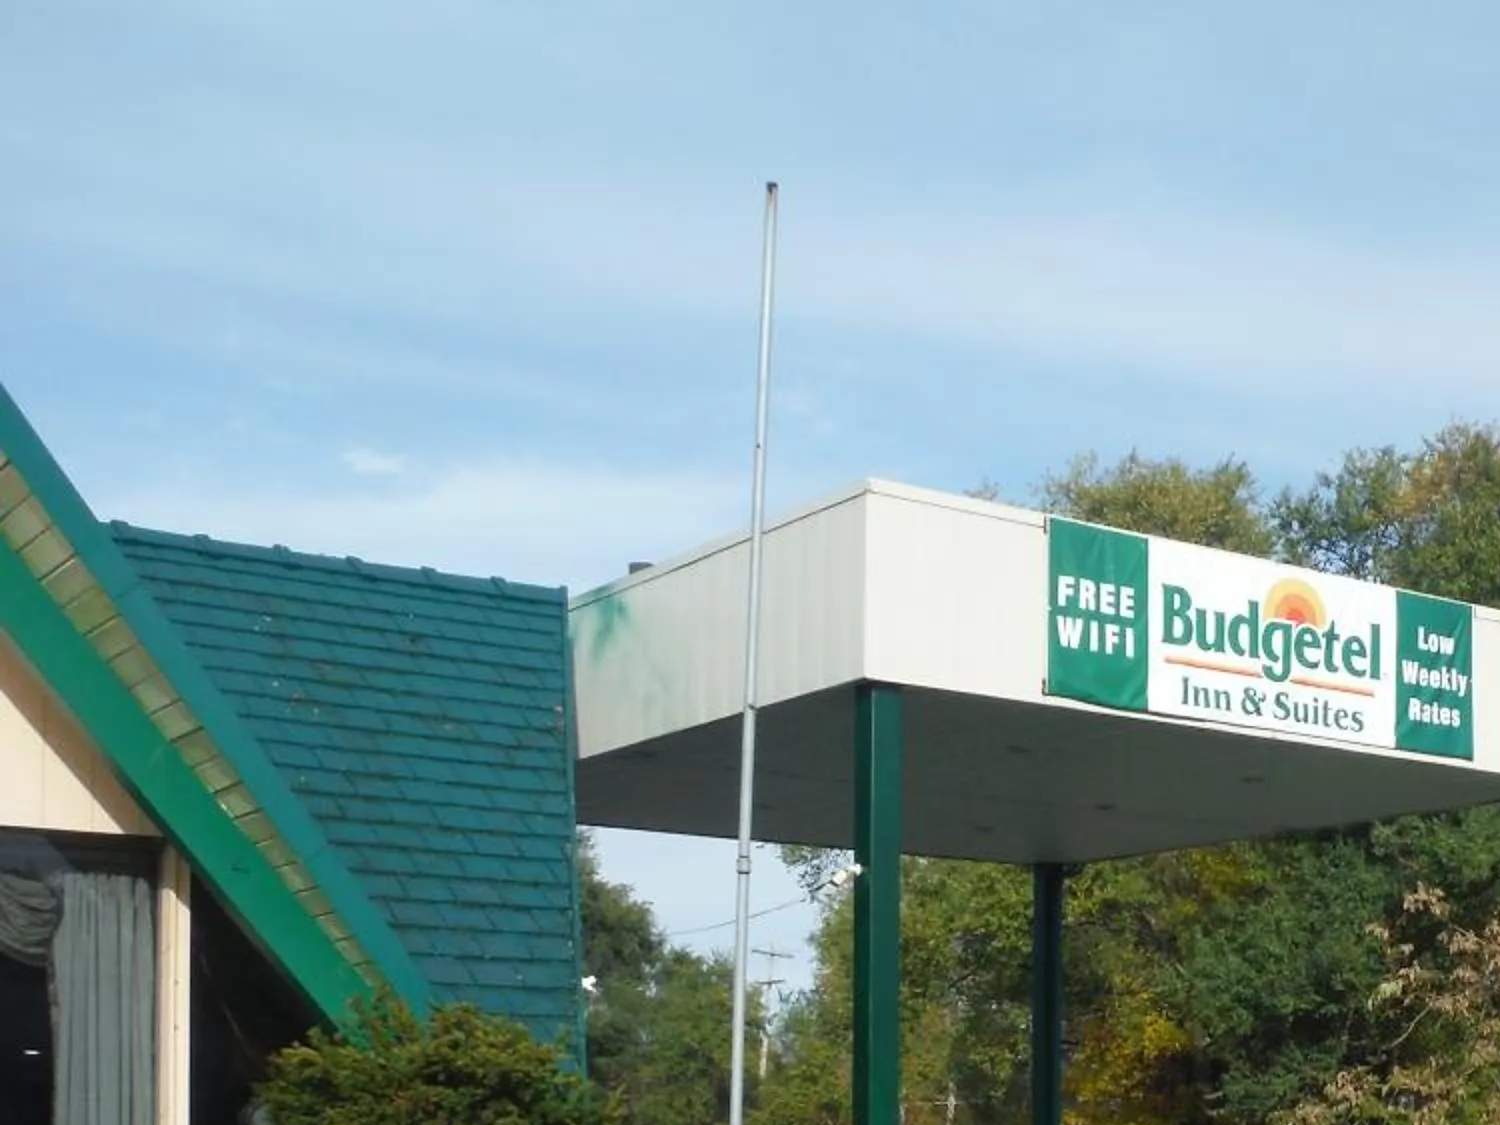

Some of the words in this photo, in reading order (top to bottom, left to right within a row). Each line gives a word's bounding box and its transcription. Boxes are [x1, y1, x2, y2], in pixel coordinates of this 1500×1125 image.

[1057, 576, 1136, 619] FREE
[1057, 616, 1136, 658] WIFI
[1161, 583, 1382, 683] Budgetel
[1417, 626, 1456, 655] Low
[1401, 659, 1470, 697] Weekly
[1181, 677, 1232, 713] Inn
[1239, 686, 1267, 717] &
[1272, 692, 1365, 733] Suites
[1408, 697, 1462, 729] Rates
